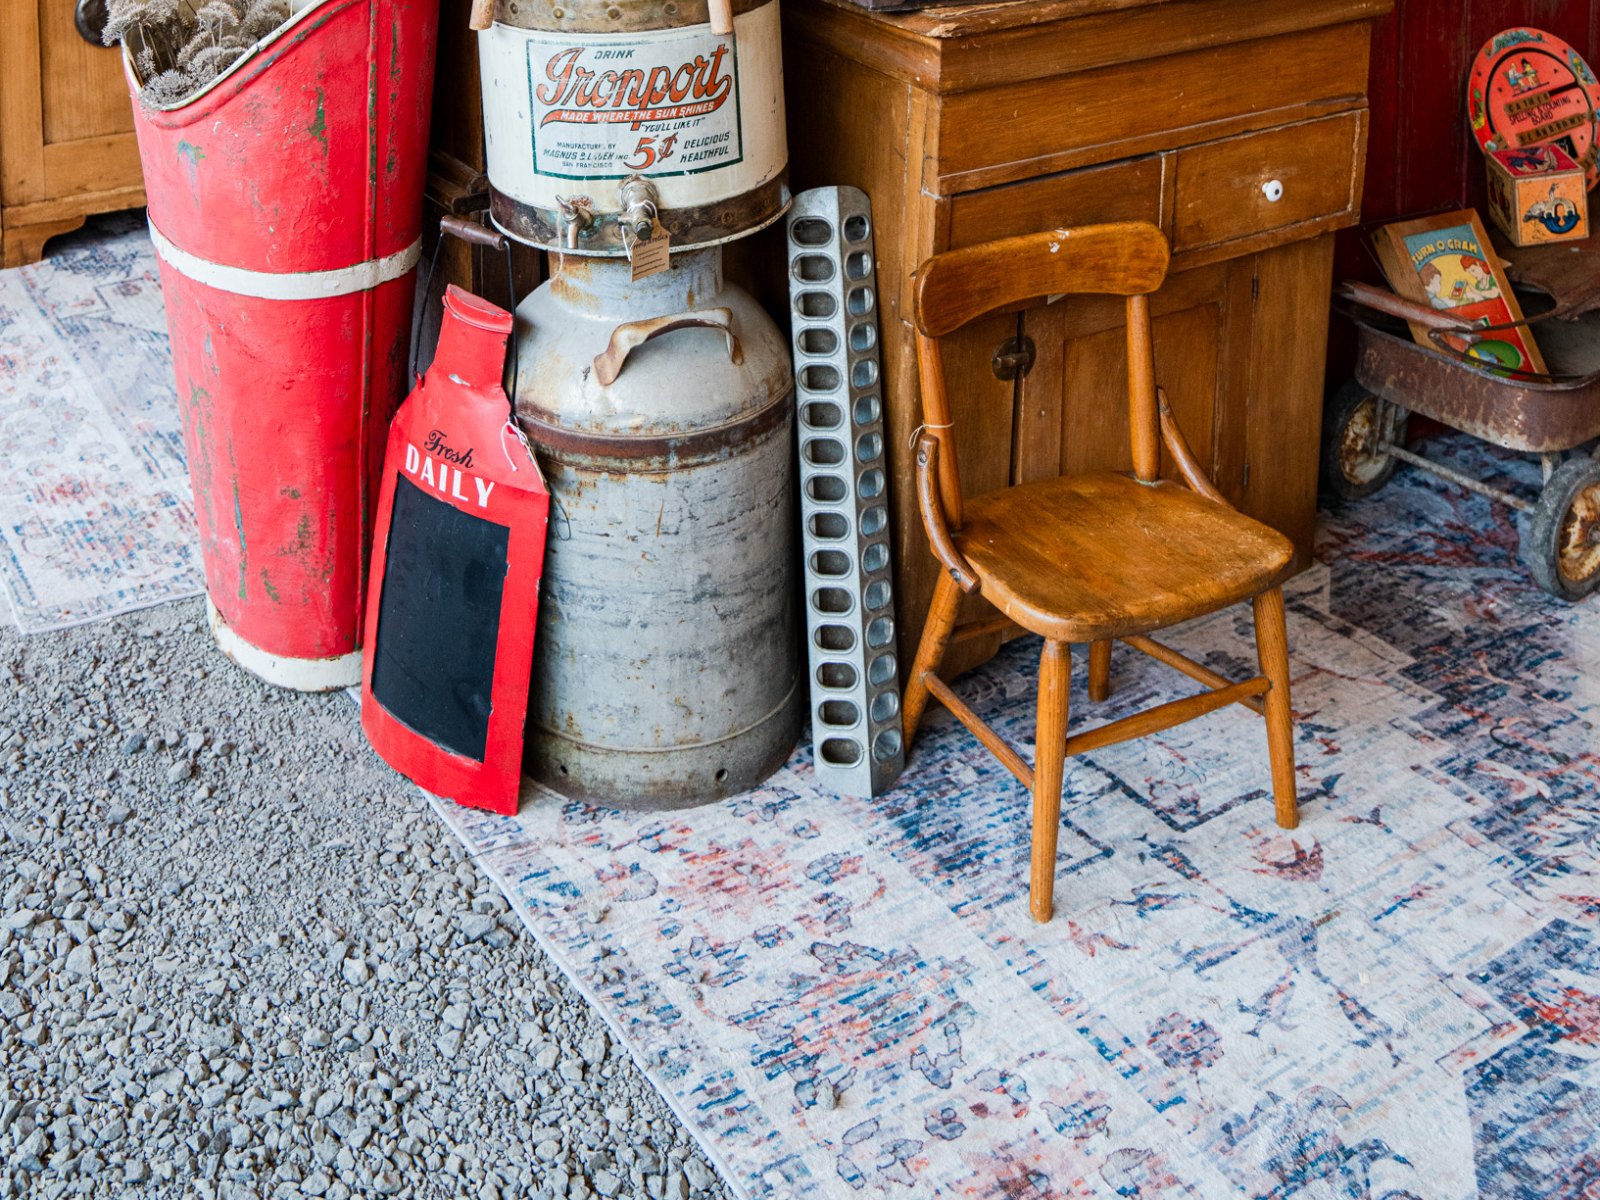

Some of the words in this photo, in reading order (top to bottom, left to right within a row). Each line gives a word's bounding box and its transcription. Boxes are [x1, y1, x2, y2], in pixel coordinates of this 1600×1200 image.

[594, 48, 636, 60] DRINK
[536, 43, 732, 131] Ironport
[560, 110, 590, 122] MADE
[592, 111, 631, 122] WHERE
[633, 110, 652, 121] THE
[655, 108, 677, 119] SUN
[679, 101, 714, 116] SHINES
[673, 120, 691, 130] LIKE
[556, 142, 606, 150] MANUFACTURE
[683, 131, 730, 150] DELICIOUS
[543, 148, 578, 160] MAGNUS
[679, 146, 729, 164] HEALTHFUL
[1411, 243, 1437, 265] TURN
[1447, 238, 1478, 255] GRAM
[423, 429, 475, 469] Fresh
[405, 442, 496, 509] DAILY
